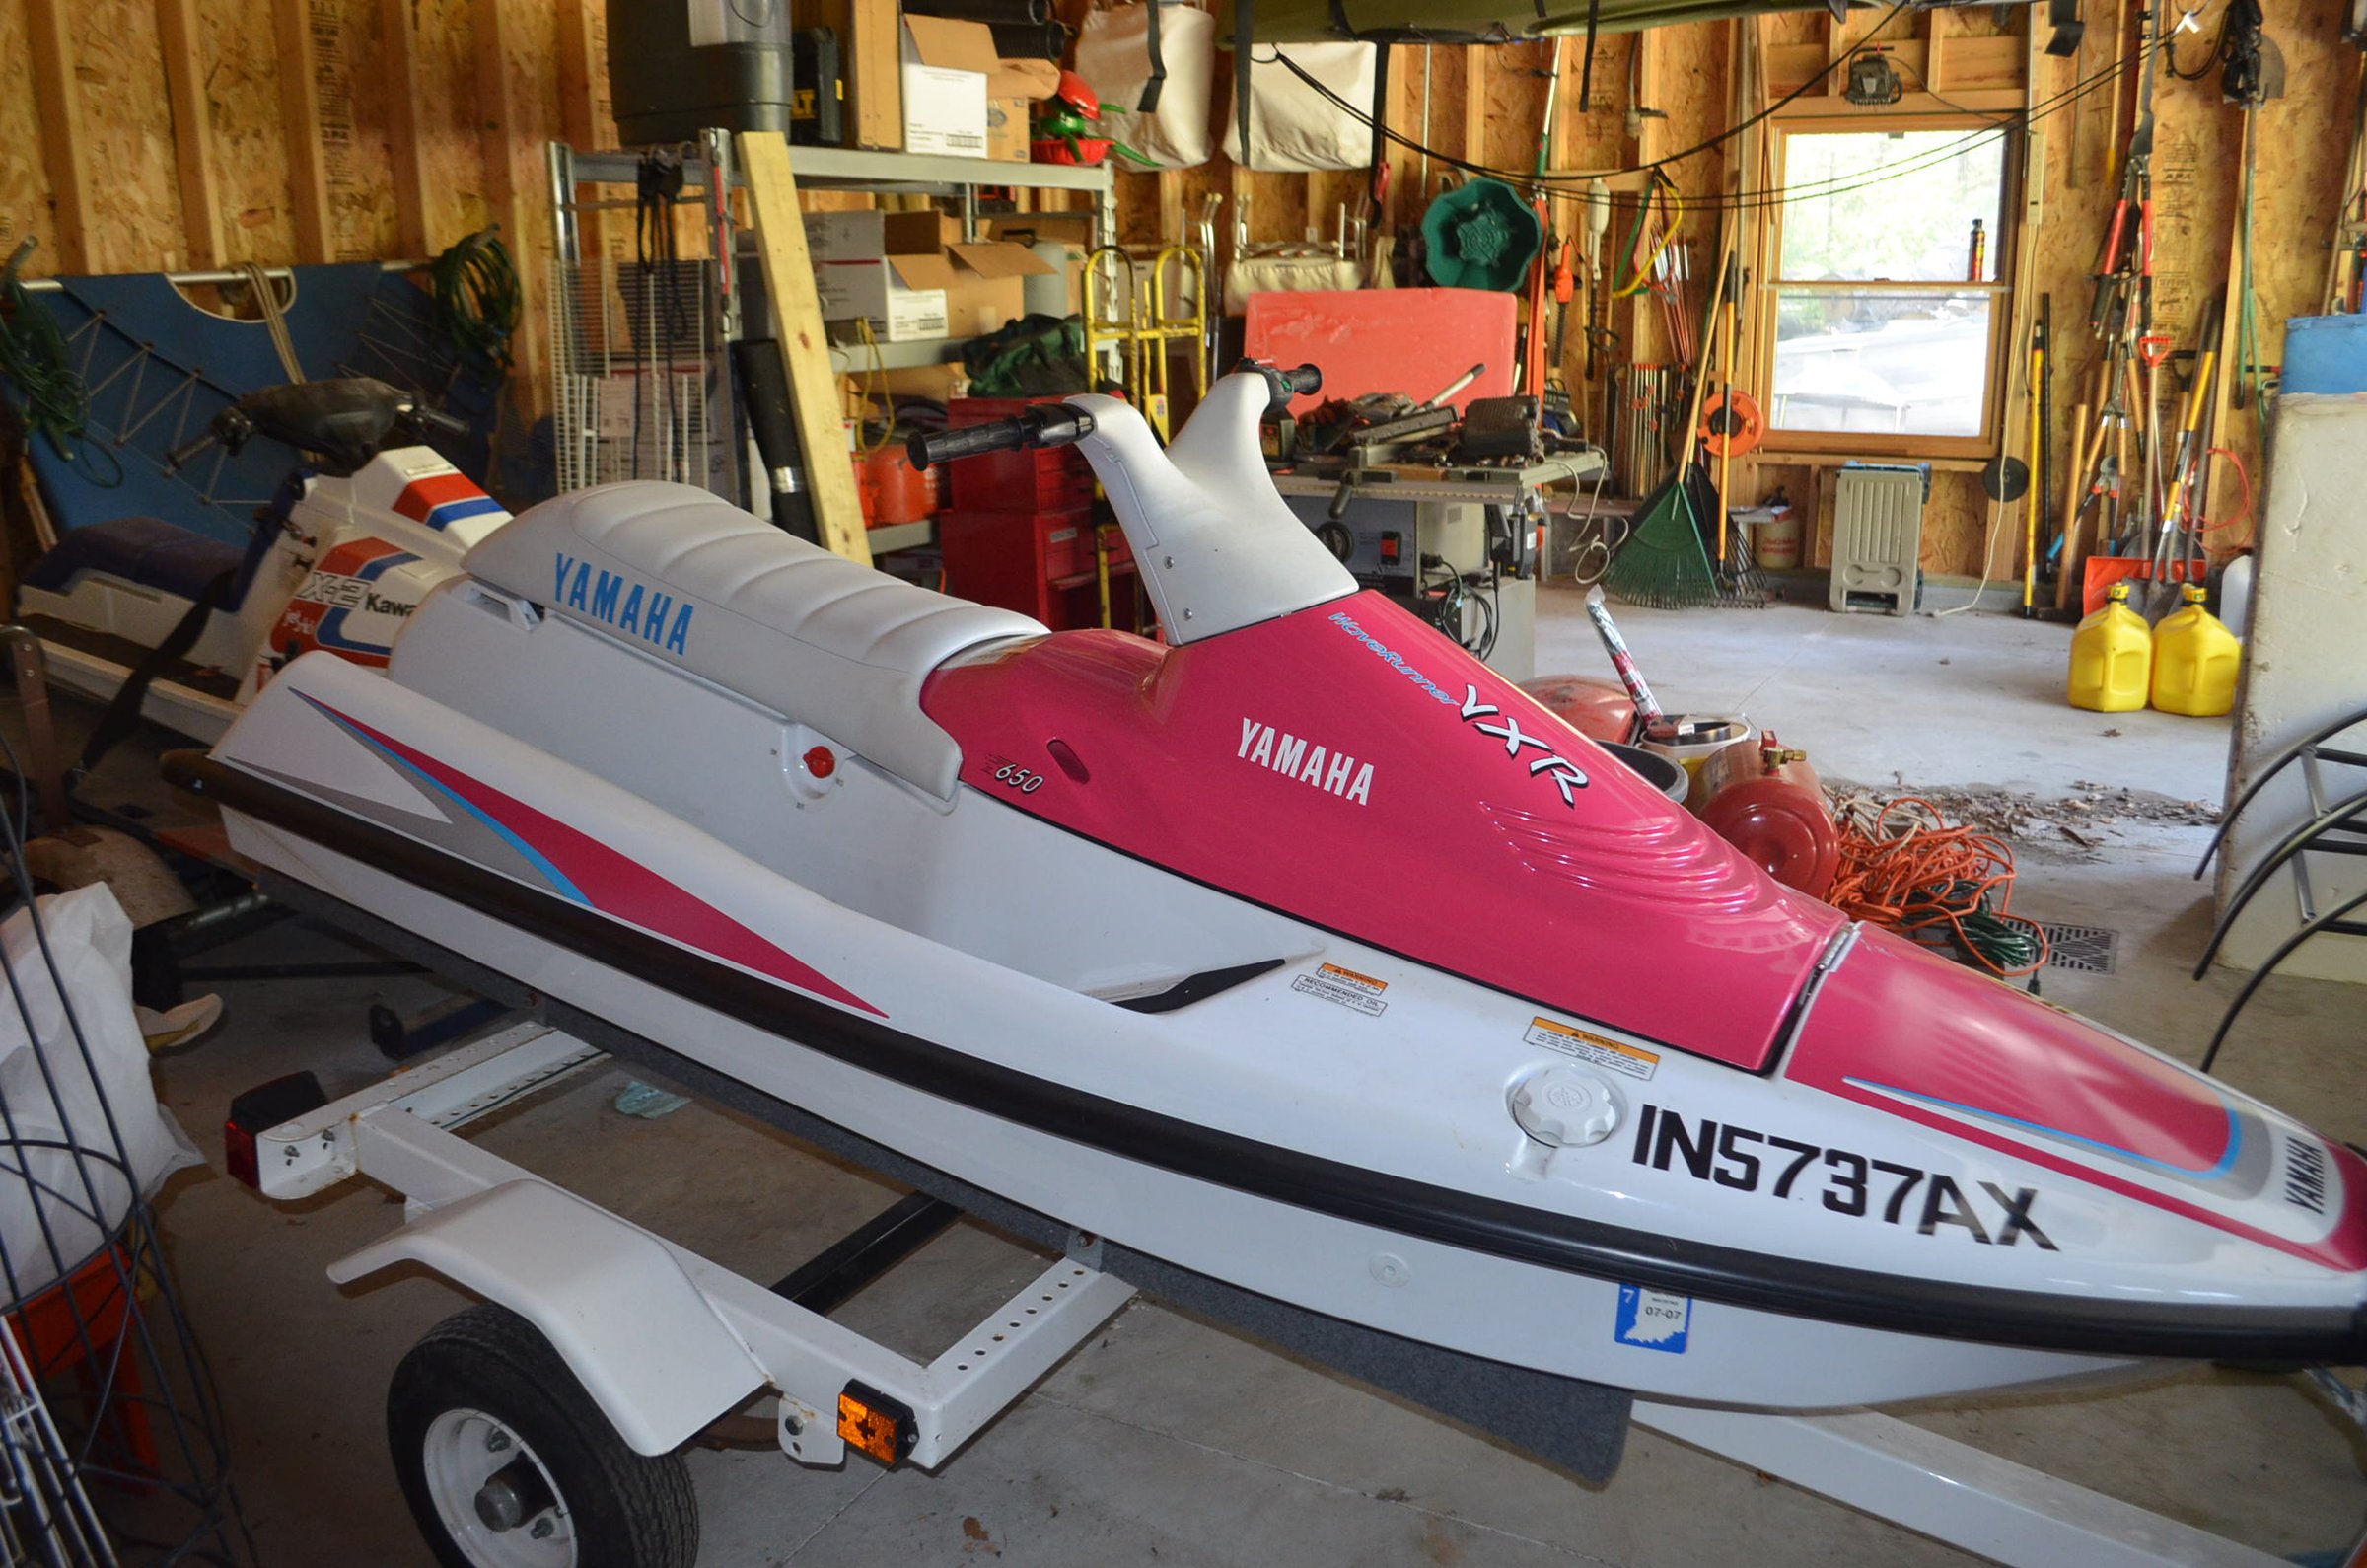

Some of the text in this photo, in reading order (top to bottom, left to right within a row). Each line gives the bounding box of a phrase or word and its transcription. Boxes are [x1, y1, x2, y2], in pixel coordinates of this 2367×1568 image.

[555, 552, 693, 655] YAMAHA
[1328, 611, 1460, 706] WaveRunner
[994, 763, 1044, 793] 650
[1237, 717, 1375, 806] YAMAHA
[1461, 683, 1589, 809] VXR
[1304, 977, 1364, 1001] RECOMMENDED
[1632, 1104, 2059, 1252] IN5737AX
[2284, 1136, 2325, 1215] YAMAHA
[1645, 1305, 1683, 1319] 07-07
